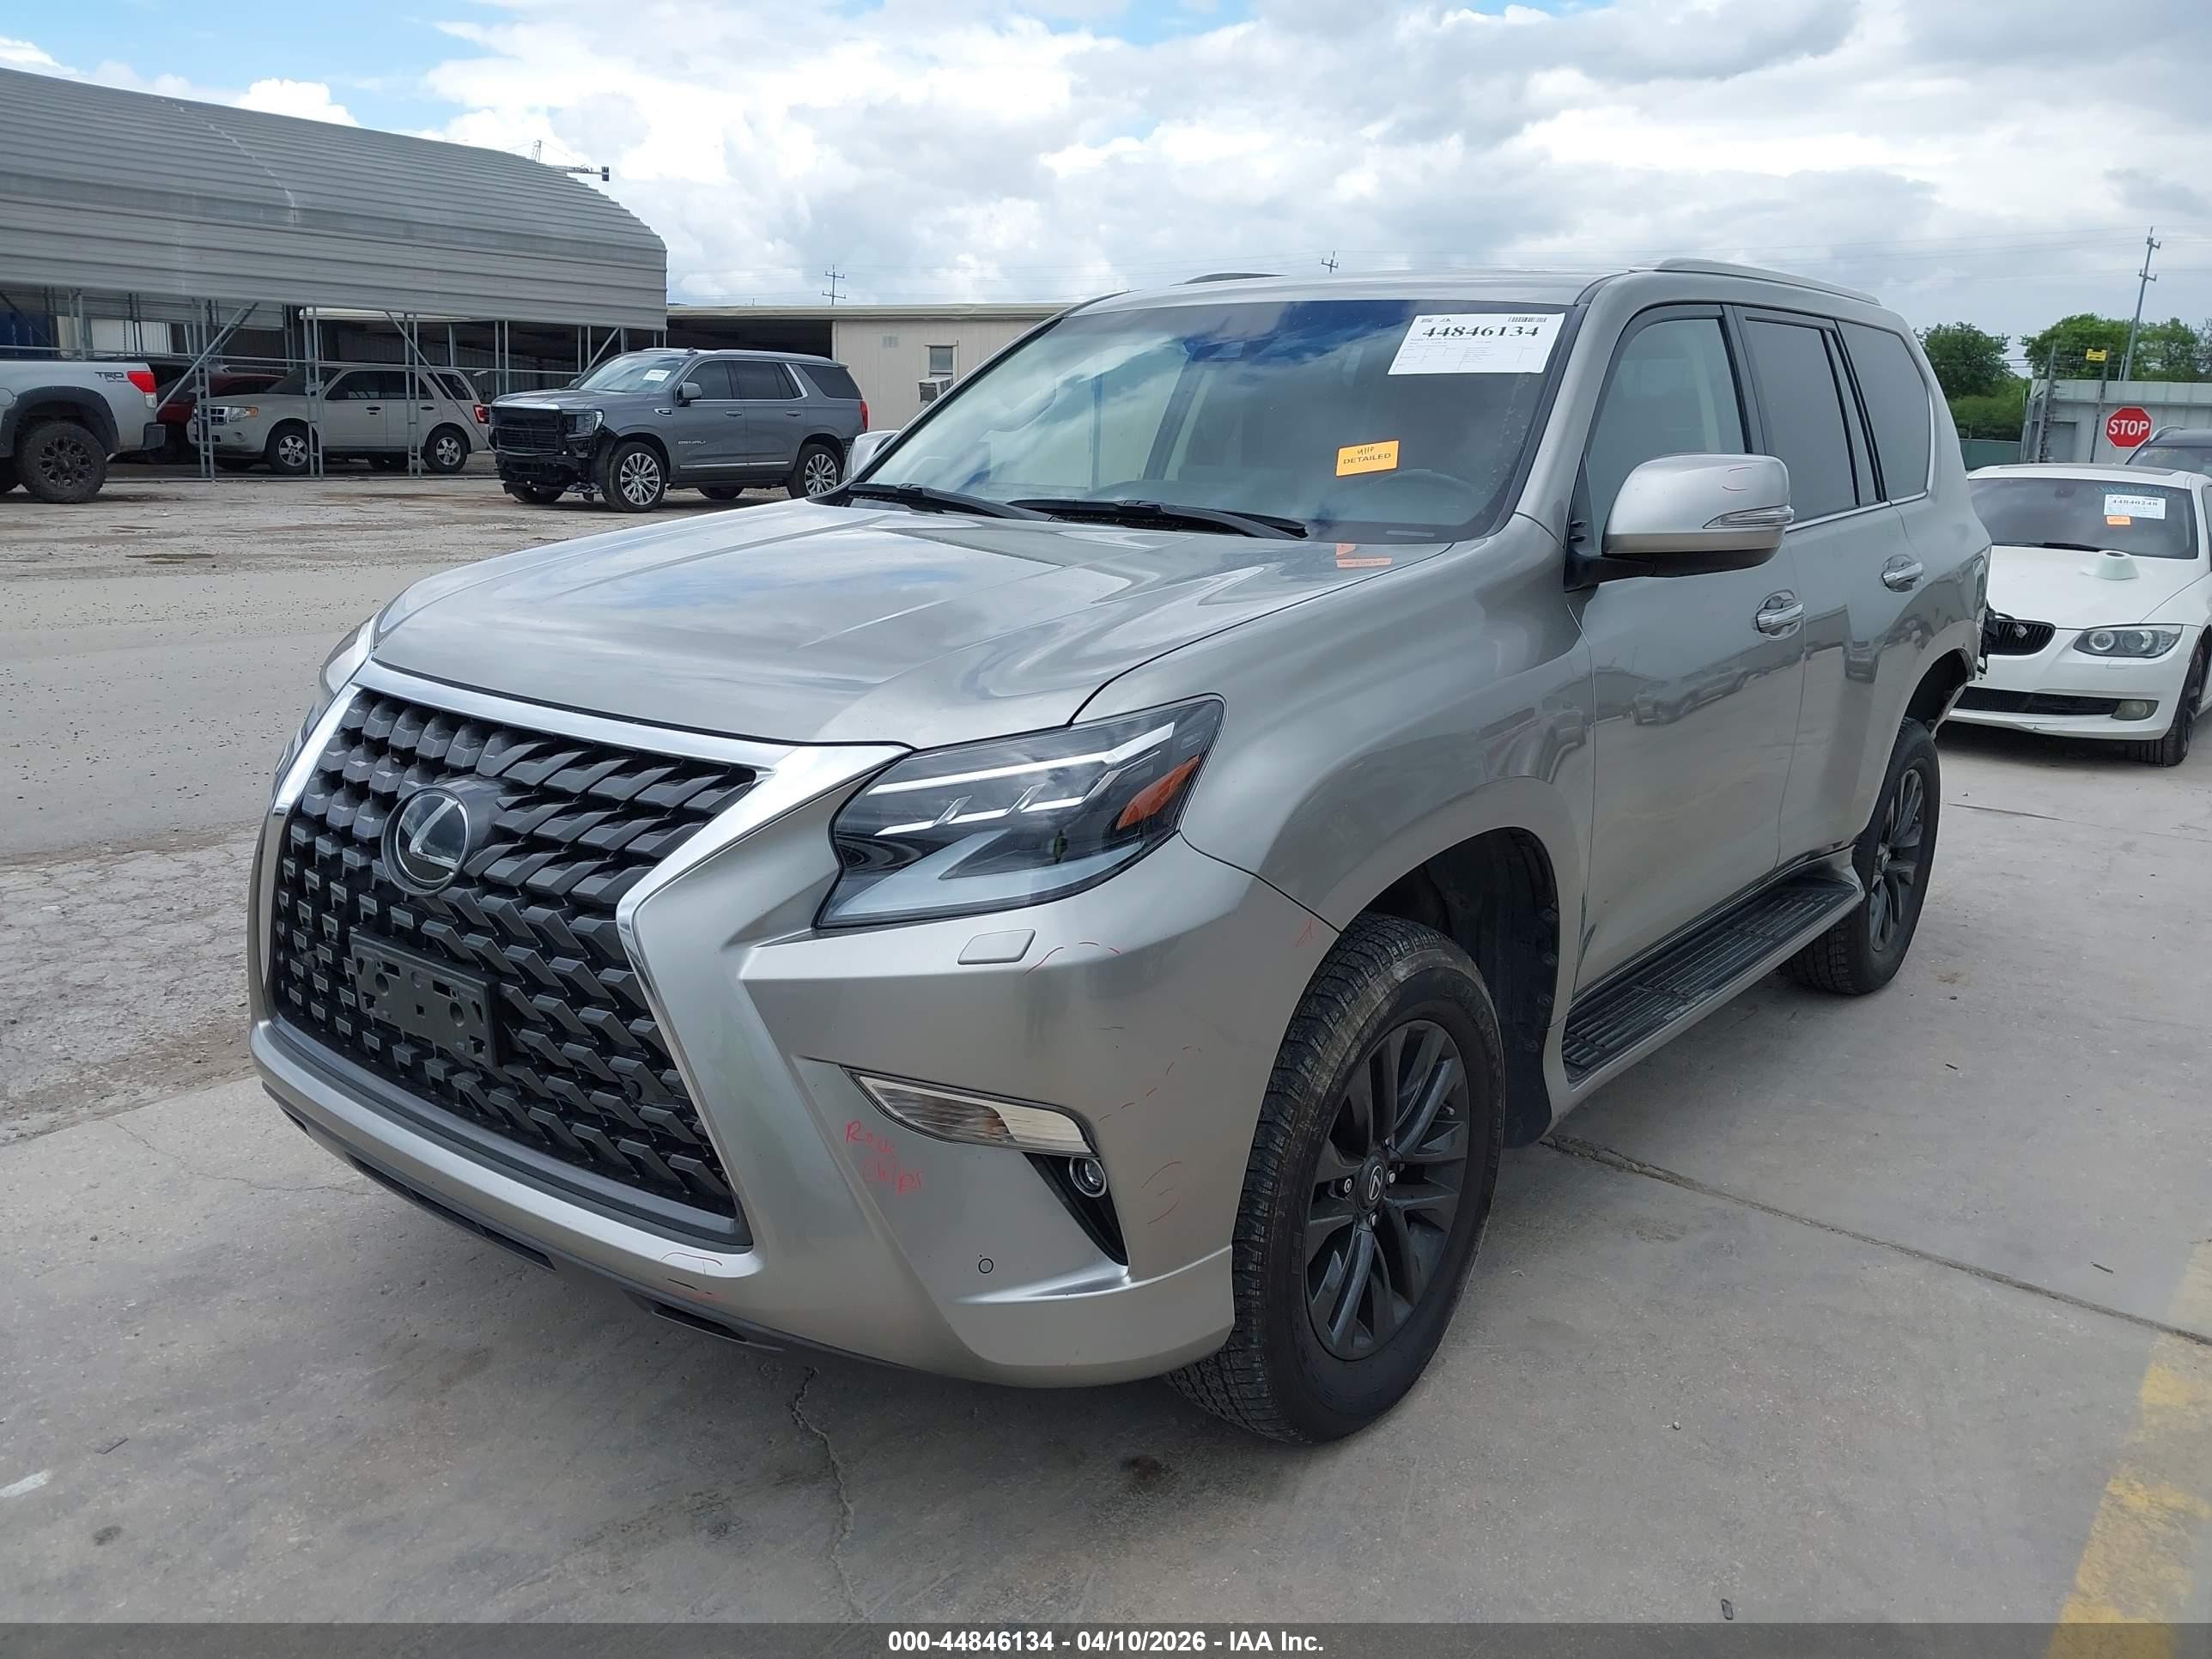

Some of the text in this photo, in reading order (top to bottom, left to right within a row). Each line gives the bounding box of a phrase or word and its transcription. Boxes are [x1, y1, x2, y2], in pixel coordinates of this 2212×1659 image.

[1422, 325, 1539, 337] 44846134
[94, 371, 125, 380] TRD
[2108, 419, 2149, 436] STOP
[1343, 453, 1391, 465] DETAILED
